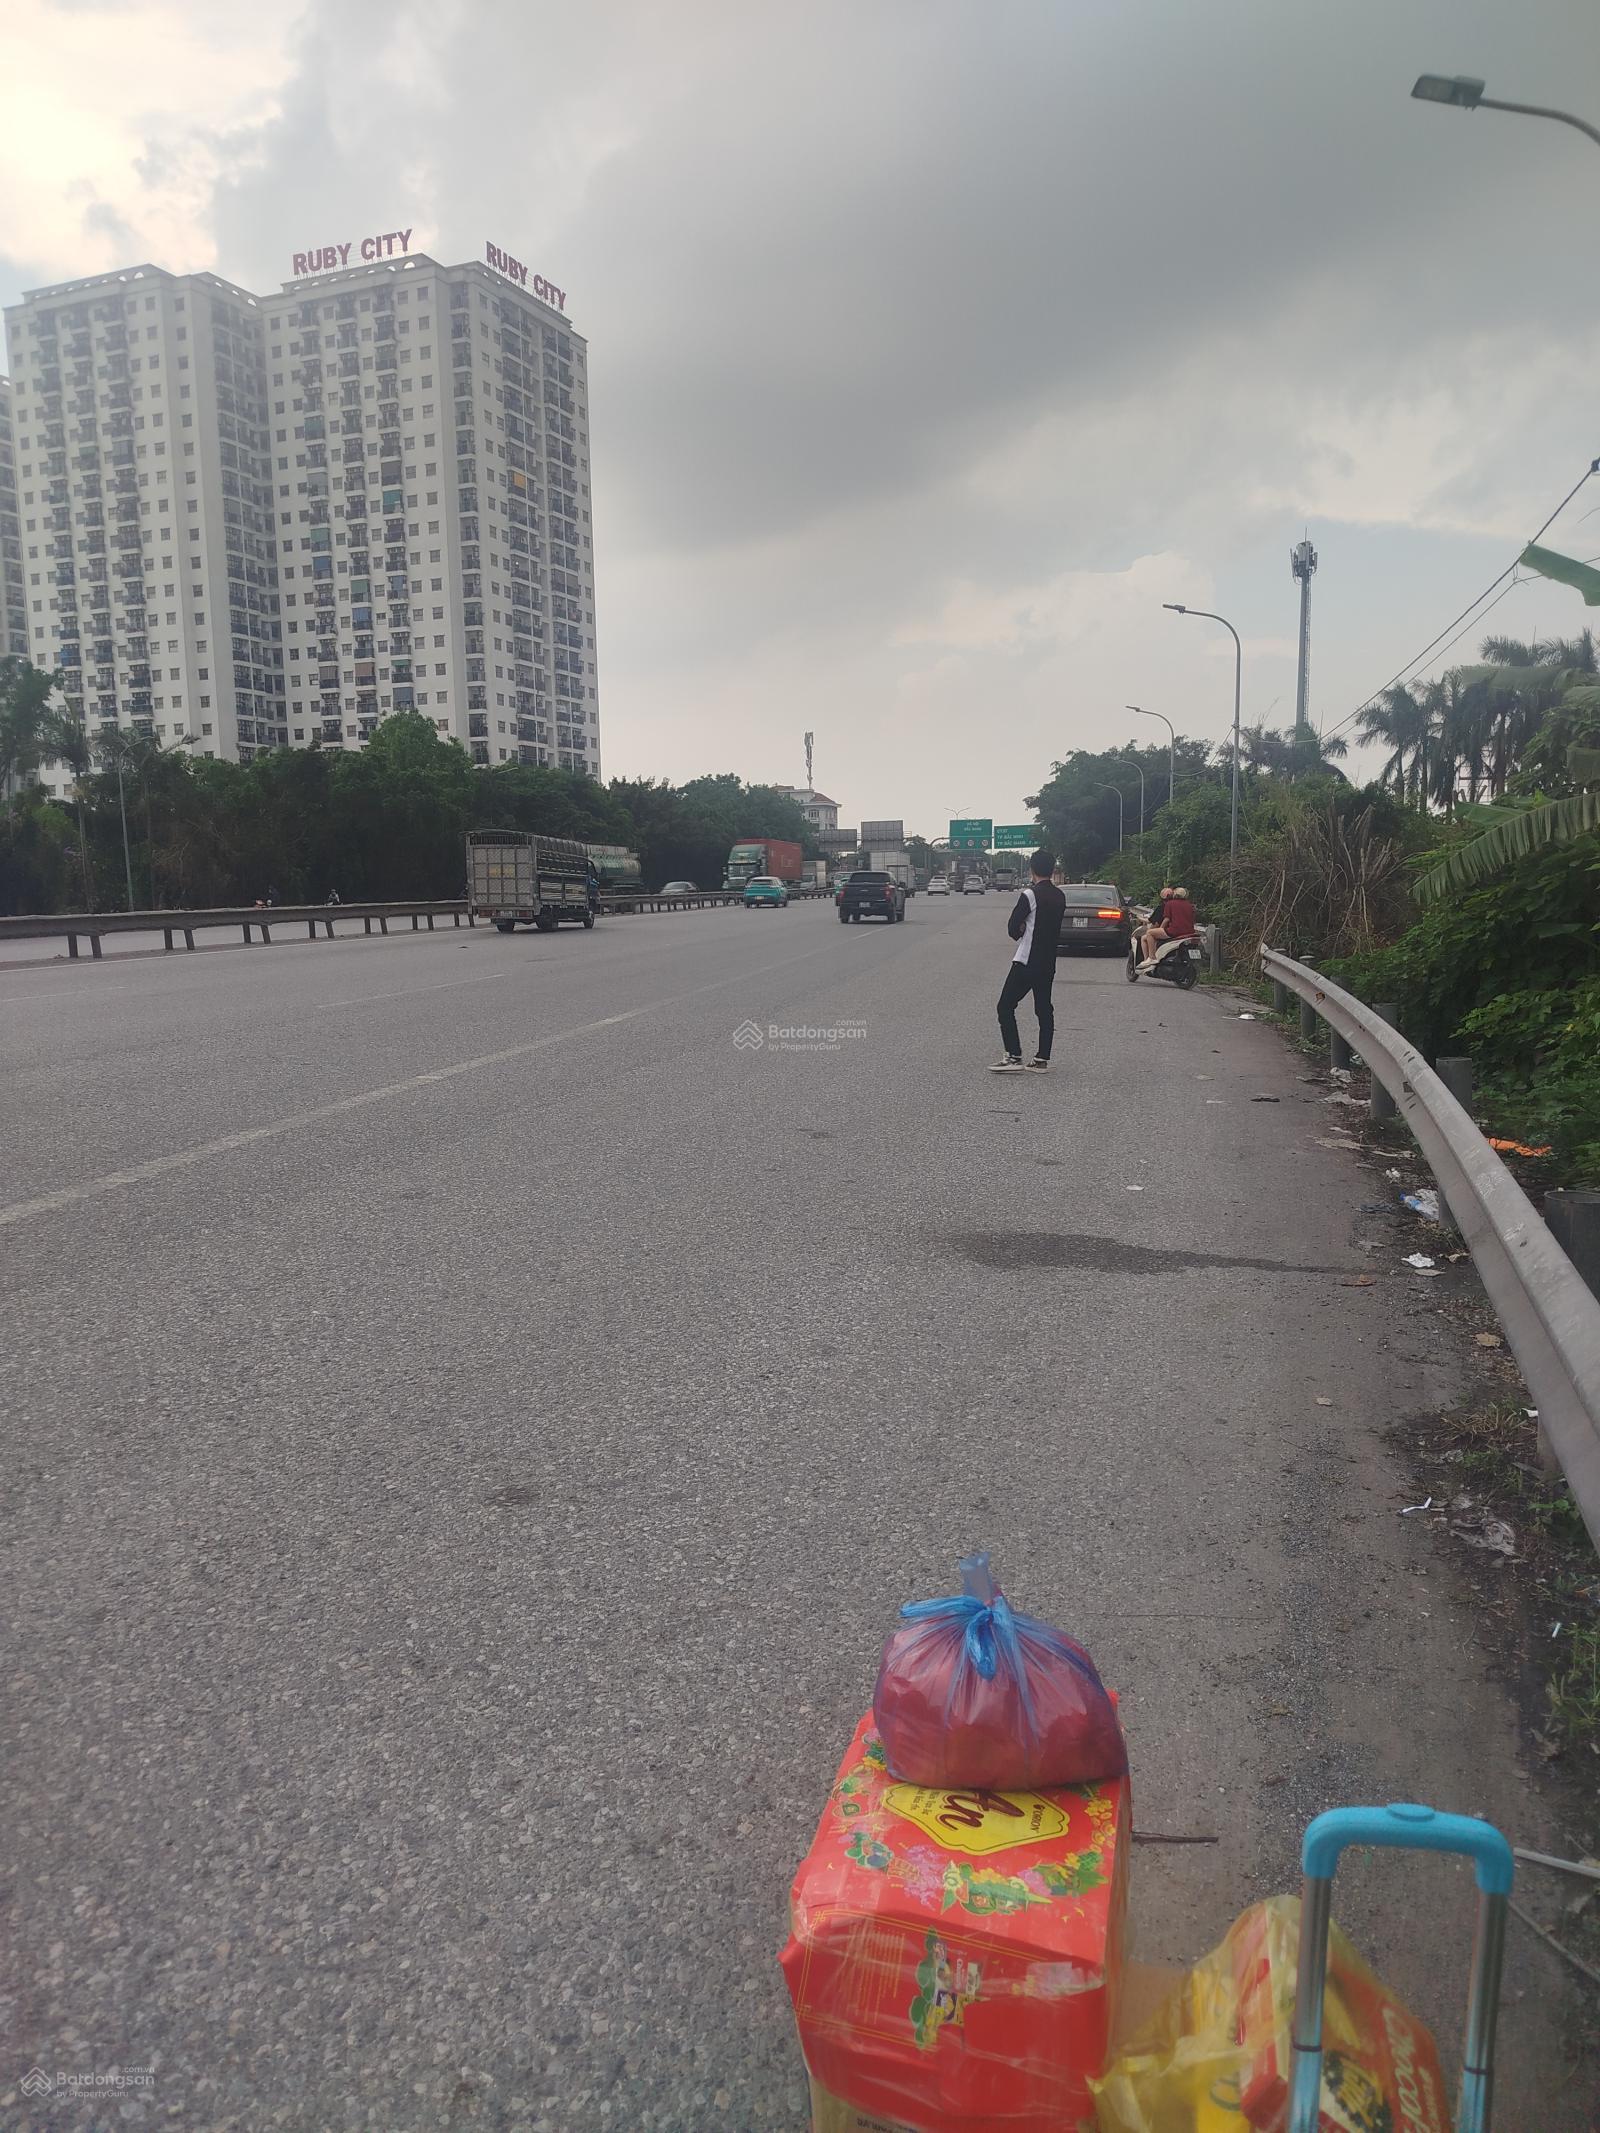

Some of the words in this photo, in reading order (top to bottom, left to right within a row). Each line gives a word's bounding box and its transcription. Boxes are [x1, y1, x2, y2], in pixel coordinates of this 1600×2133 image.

[292, 242, 352, 275] RUBY
[361, 229, 412, 261] CITY
[486, 241, 528, 286] RUBY
[533, 274, 567, 311] CITY
